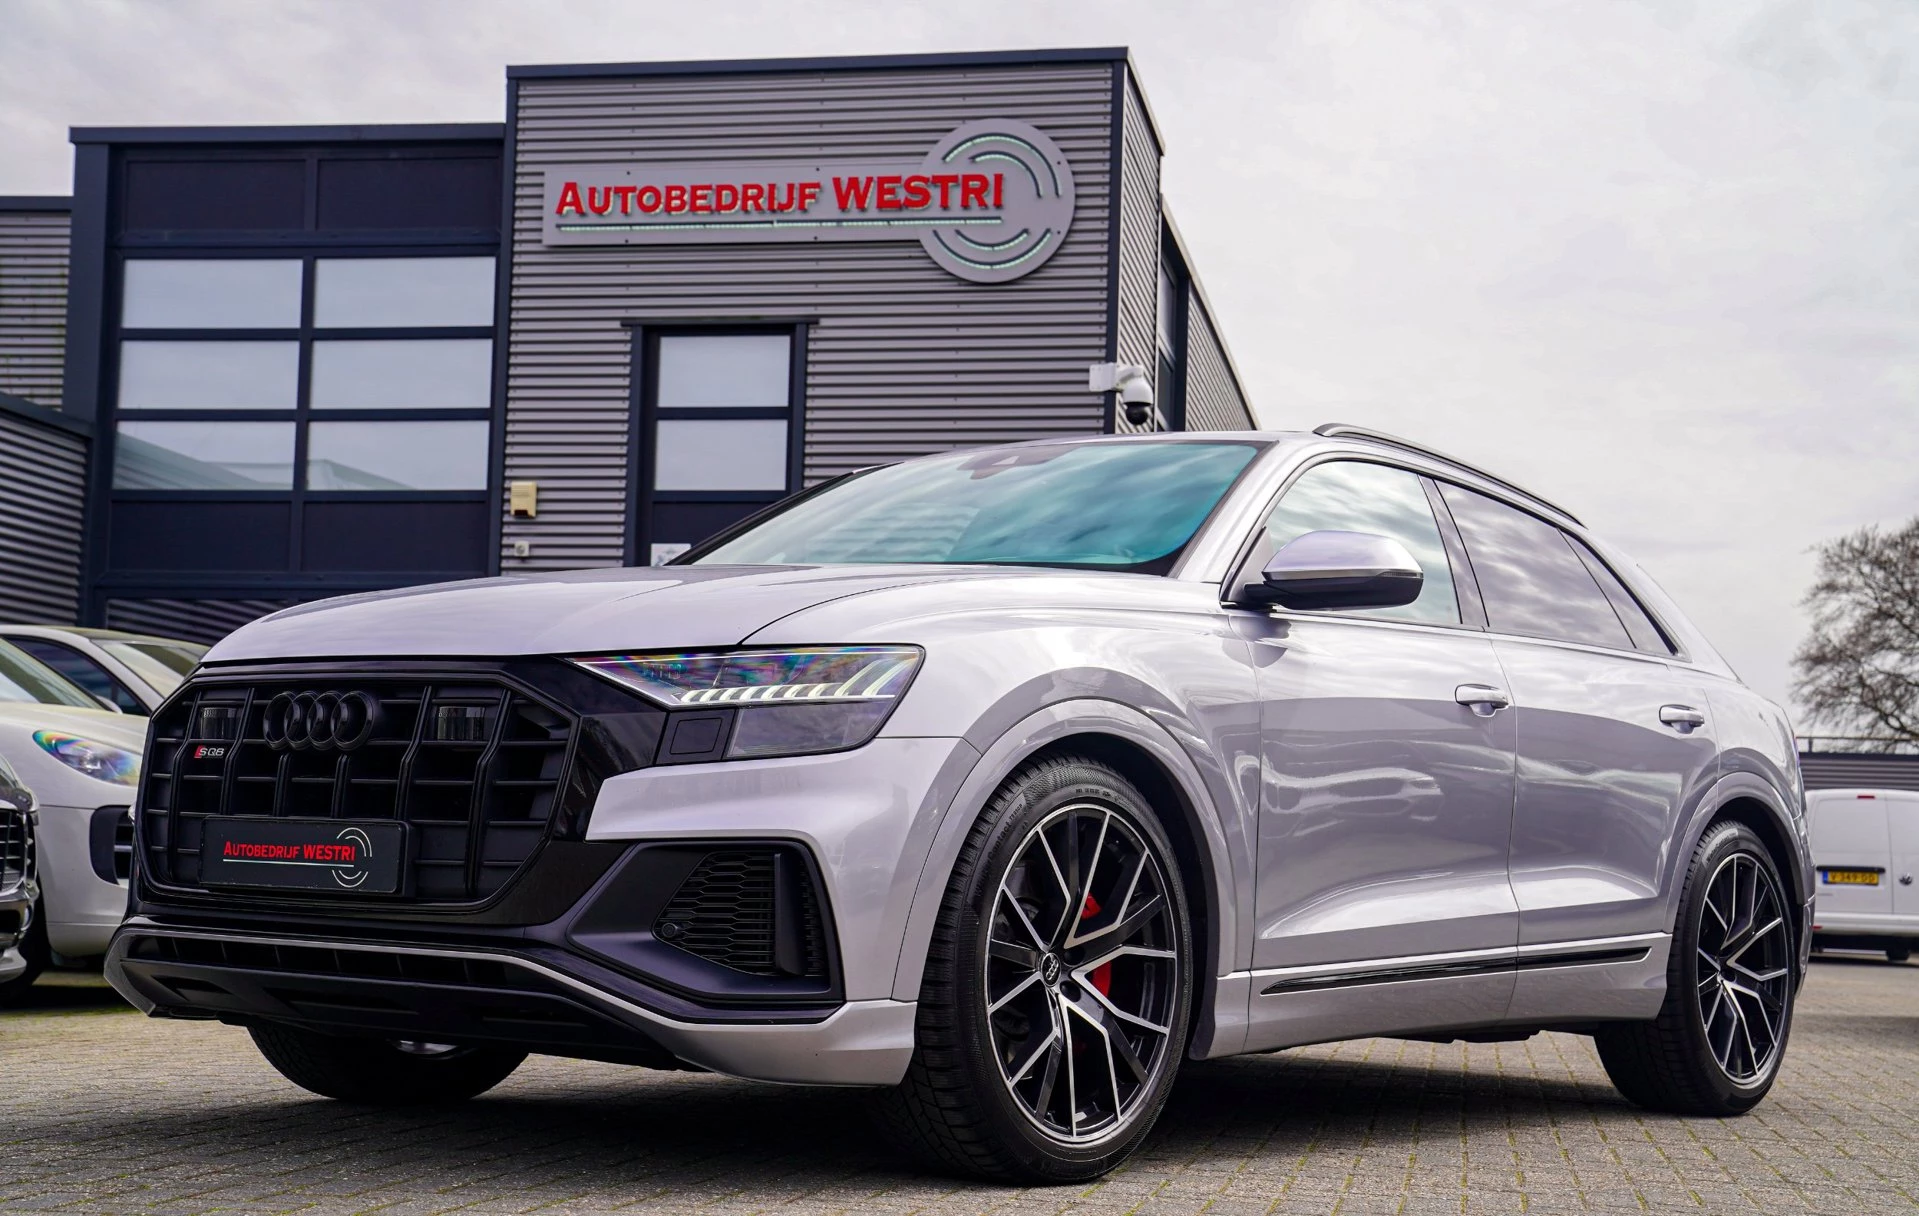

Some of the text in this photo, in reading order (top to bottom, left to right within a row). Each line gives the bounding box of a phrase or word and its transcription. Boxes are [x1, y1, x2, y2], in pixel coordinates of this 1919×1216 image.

[555, 173, 1004, 215] AUTOBEDRIJF WESTRI
[198, 747, 225, 757] SQ8
[223, 841, 356, 861] AUTOBEDRIJF WESTRI
